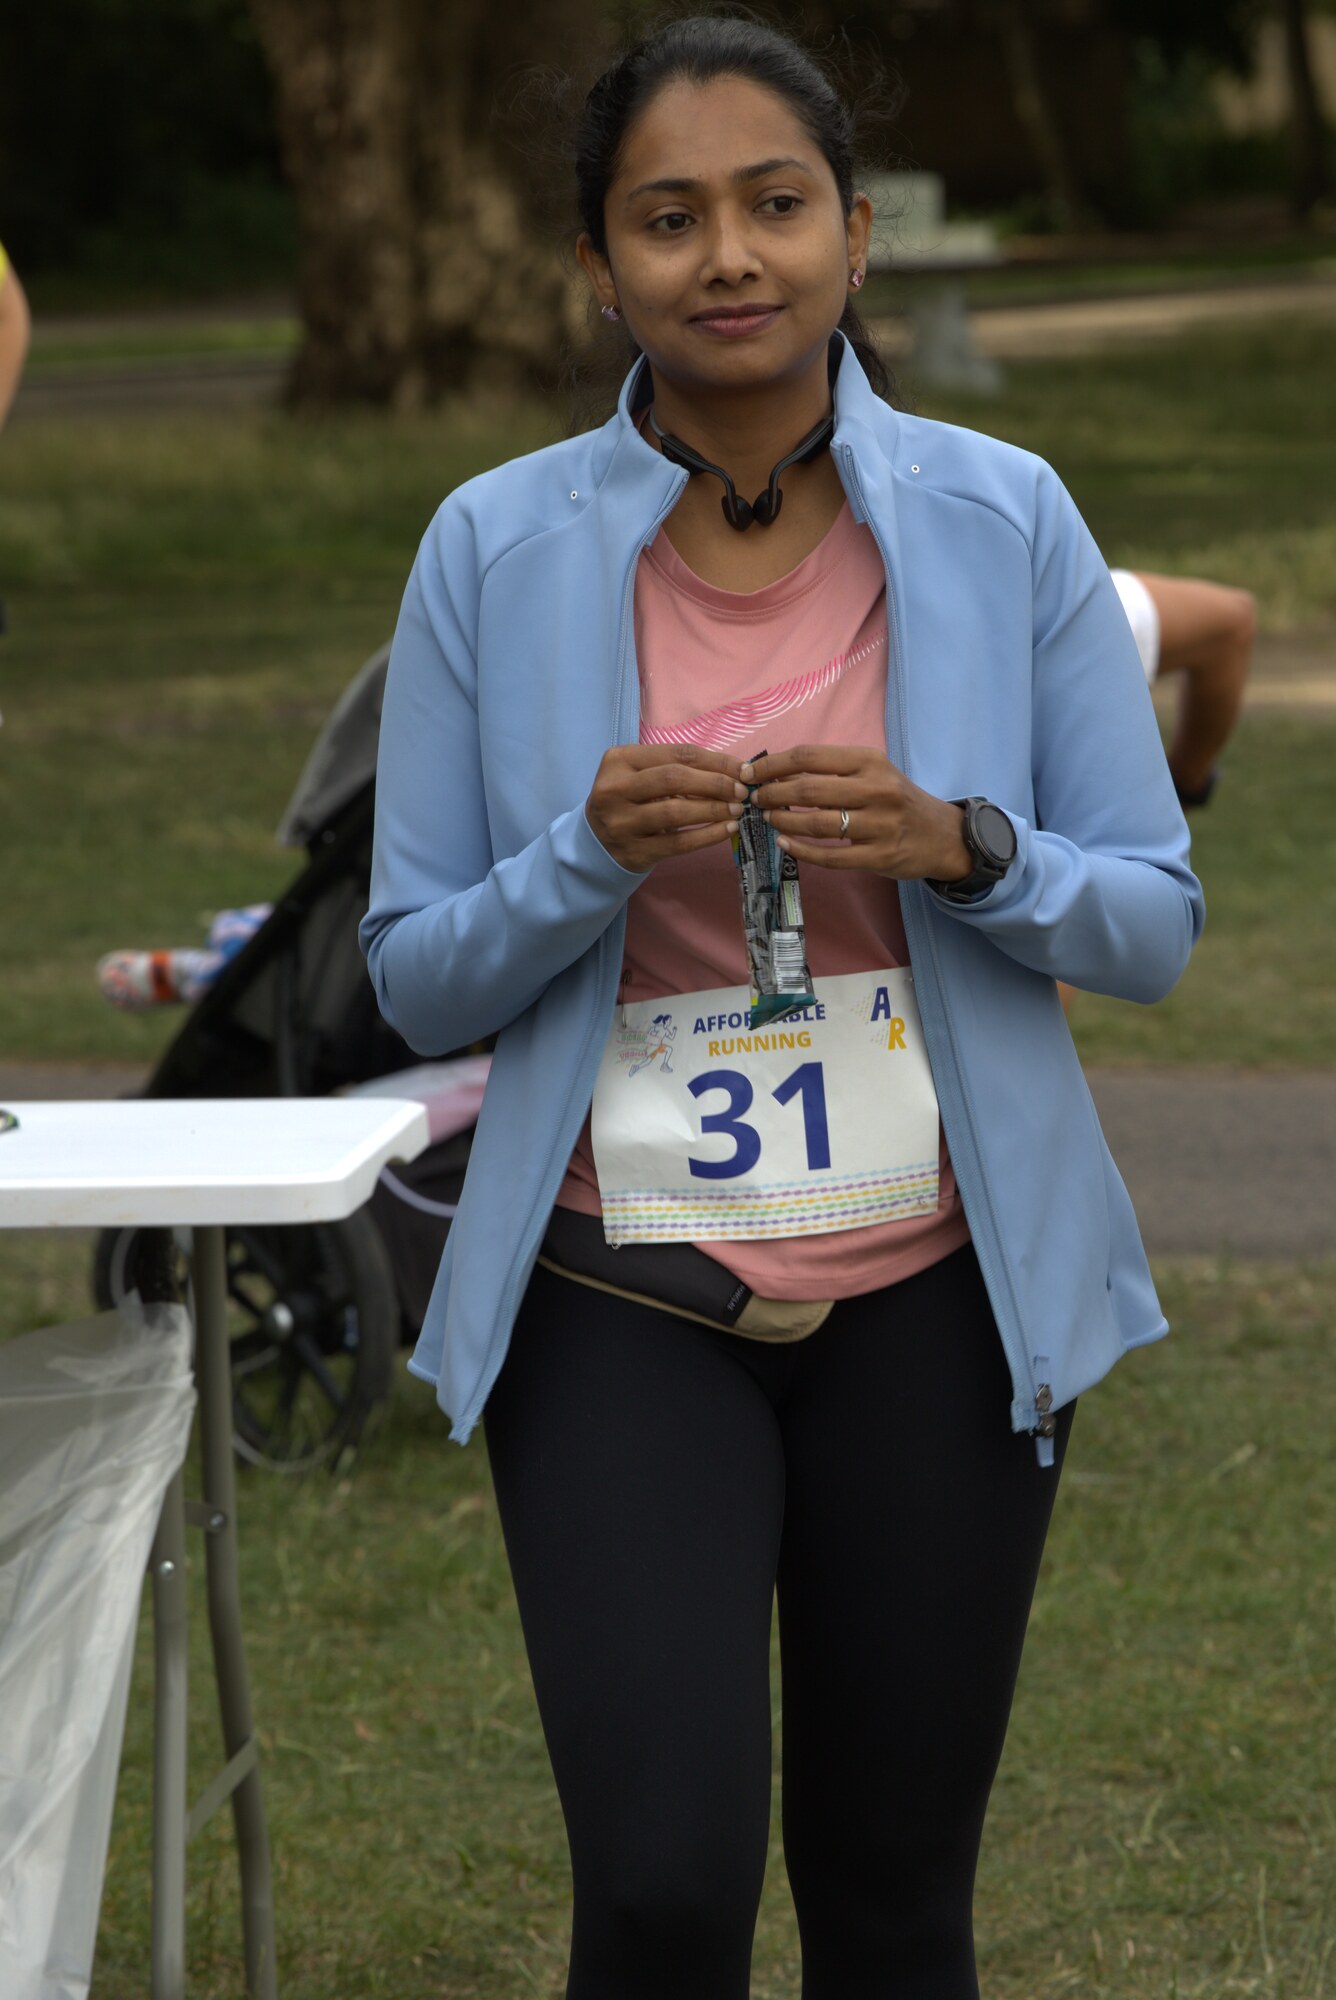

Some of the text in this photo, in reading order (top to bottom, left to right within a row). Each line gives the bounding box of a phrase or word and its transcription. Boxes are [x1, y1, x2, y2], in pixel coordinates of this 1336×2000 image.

[693, 1004, 827, 1034] AFFORBLE
[871, 986, 892, 1022] A
[708, 1031, 812, 1057] RUNNING
[888, 1017, 907, 1050] R
[686, 1061, 832, 1181] 31
